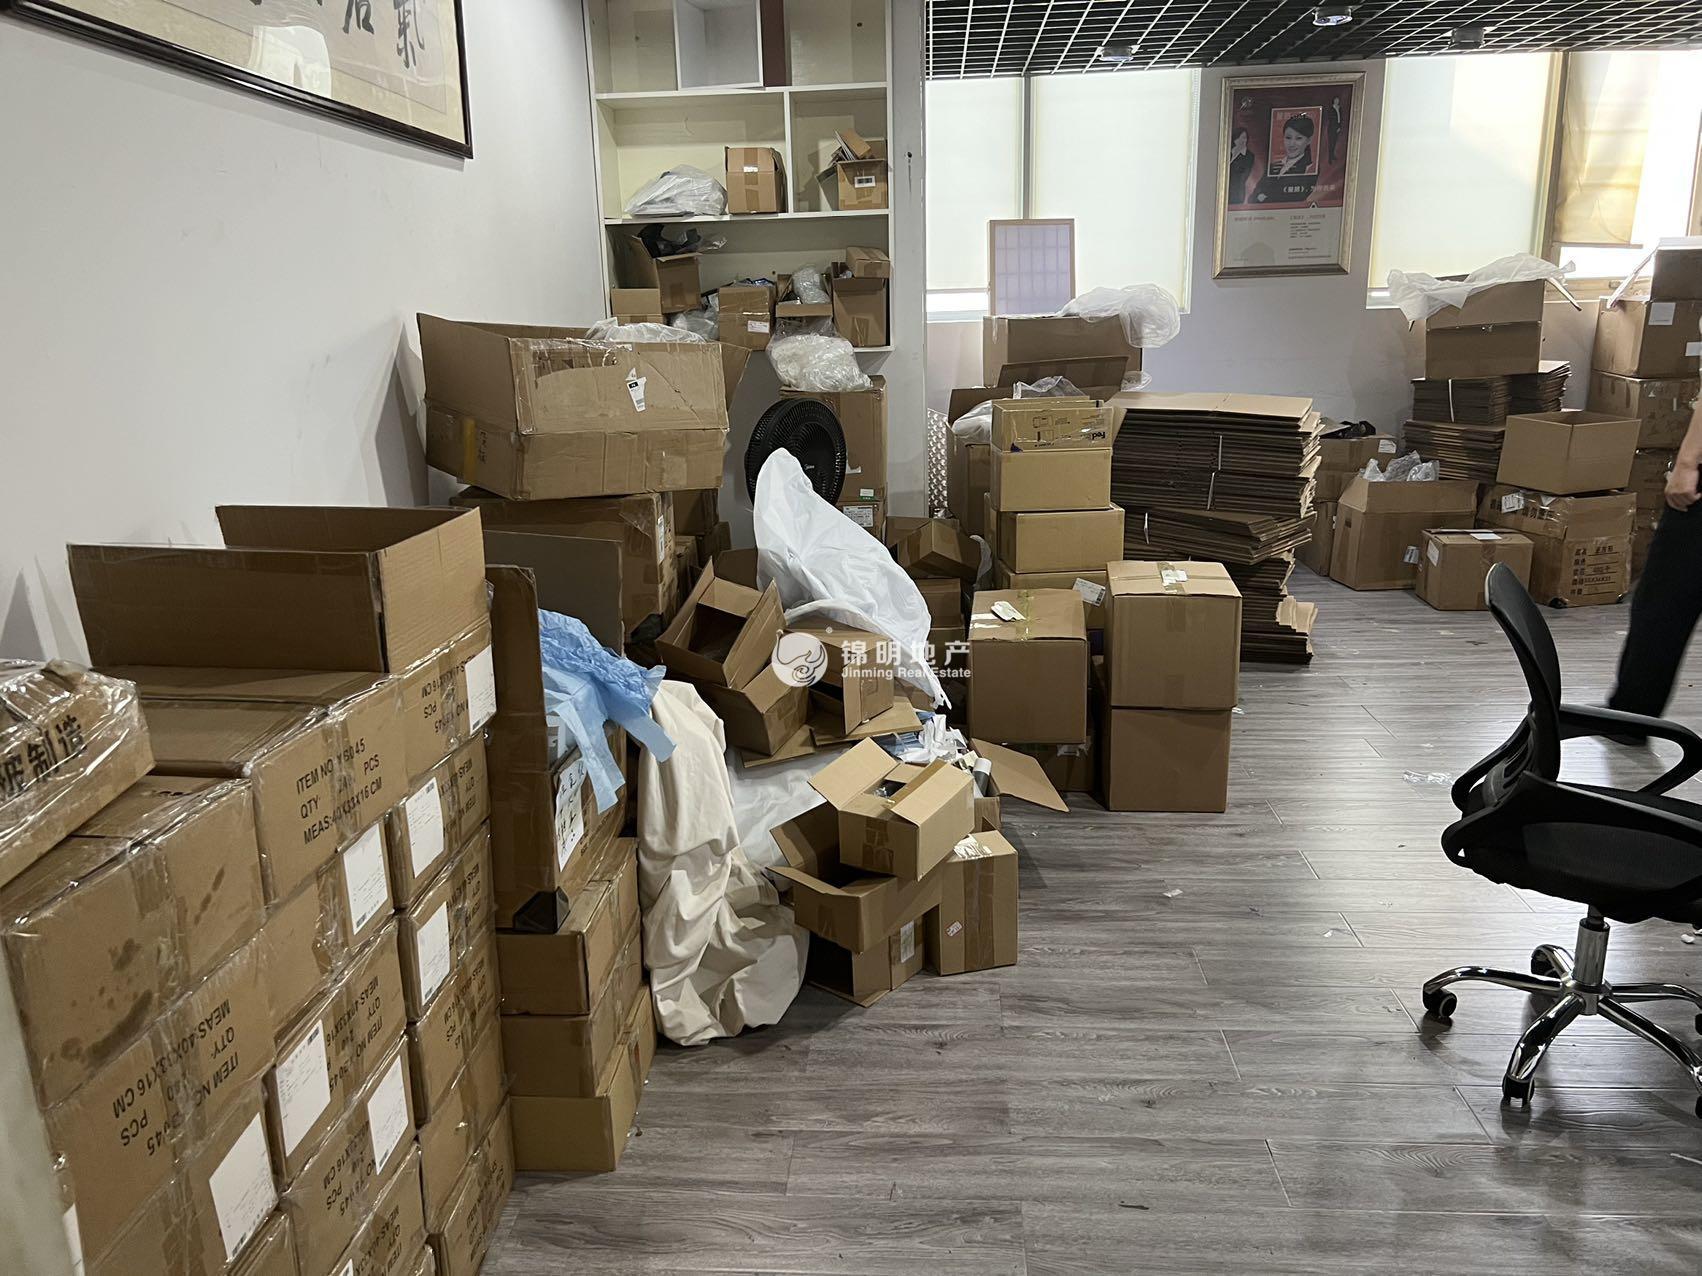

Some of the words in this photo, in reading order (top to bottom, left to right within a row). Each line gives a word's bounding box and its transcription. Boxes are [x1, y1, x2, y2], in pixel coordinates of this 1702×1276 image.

[296, 768, 319, 795] ITEM
[320, 758, 334, 778] NO
[363, 754, 380, 776] PCS
[212, 1051, 239, 1089] ITEM
[113, 1088, 135, 1119] CM
[120, 1108, 149, 1146] PCS
[326, 1181, 342, 1211] PCS
